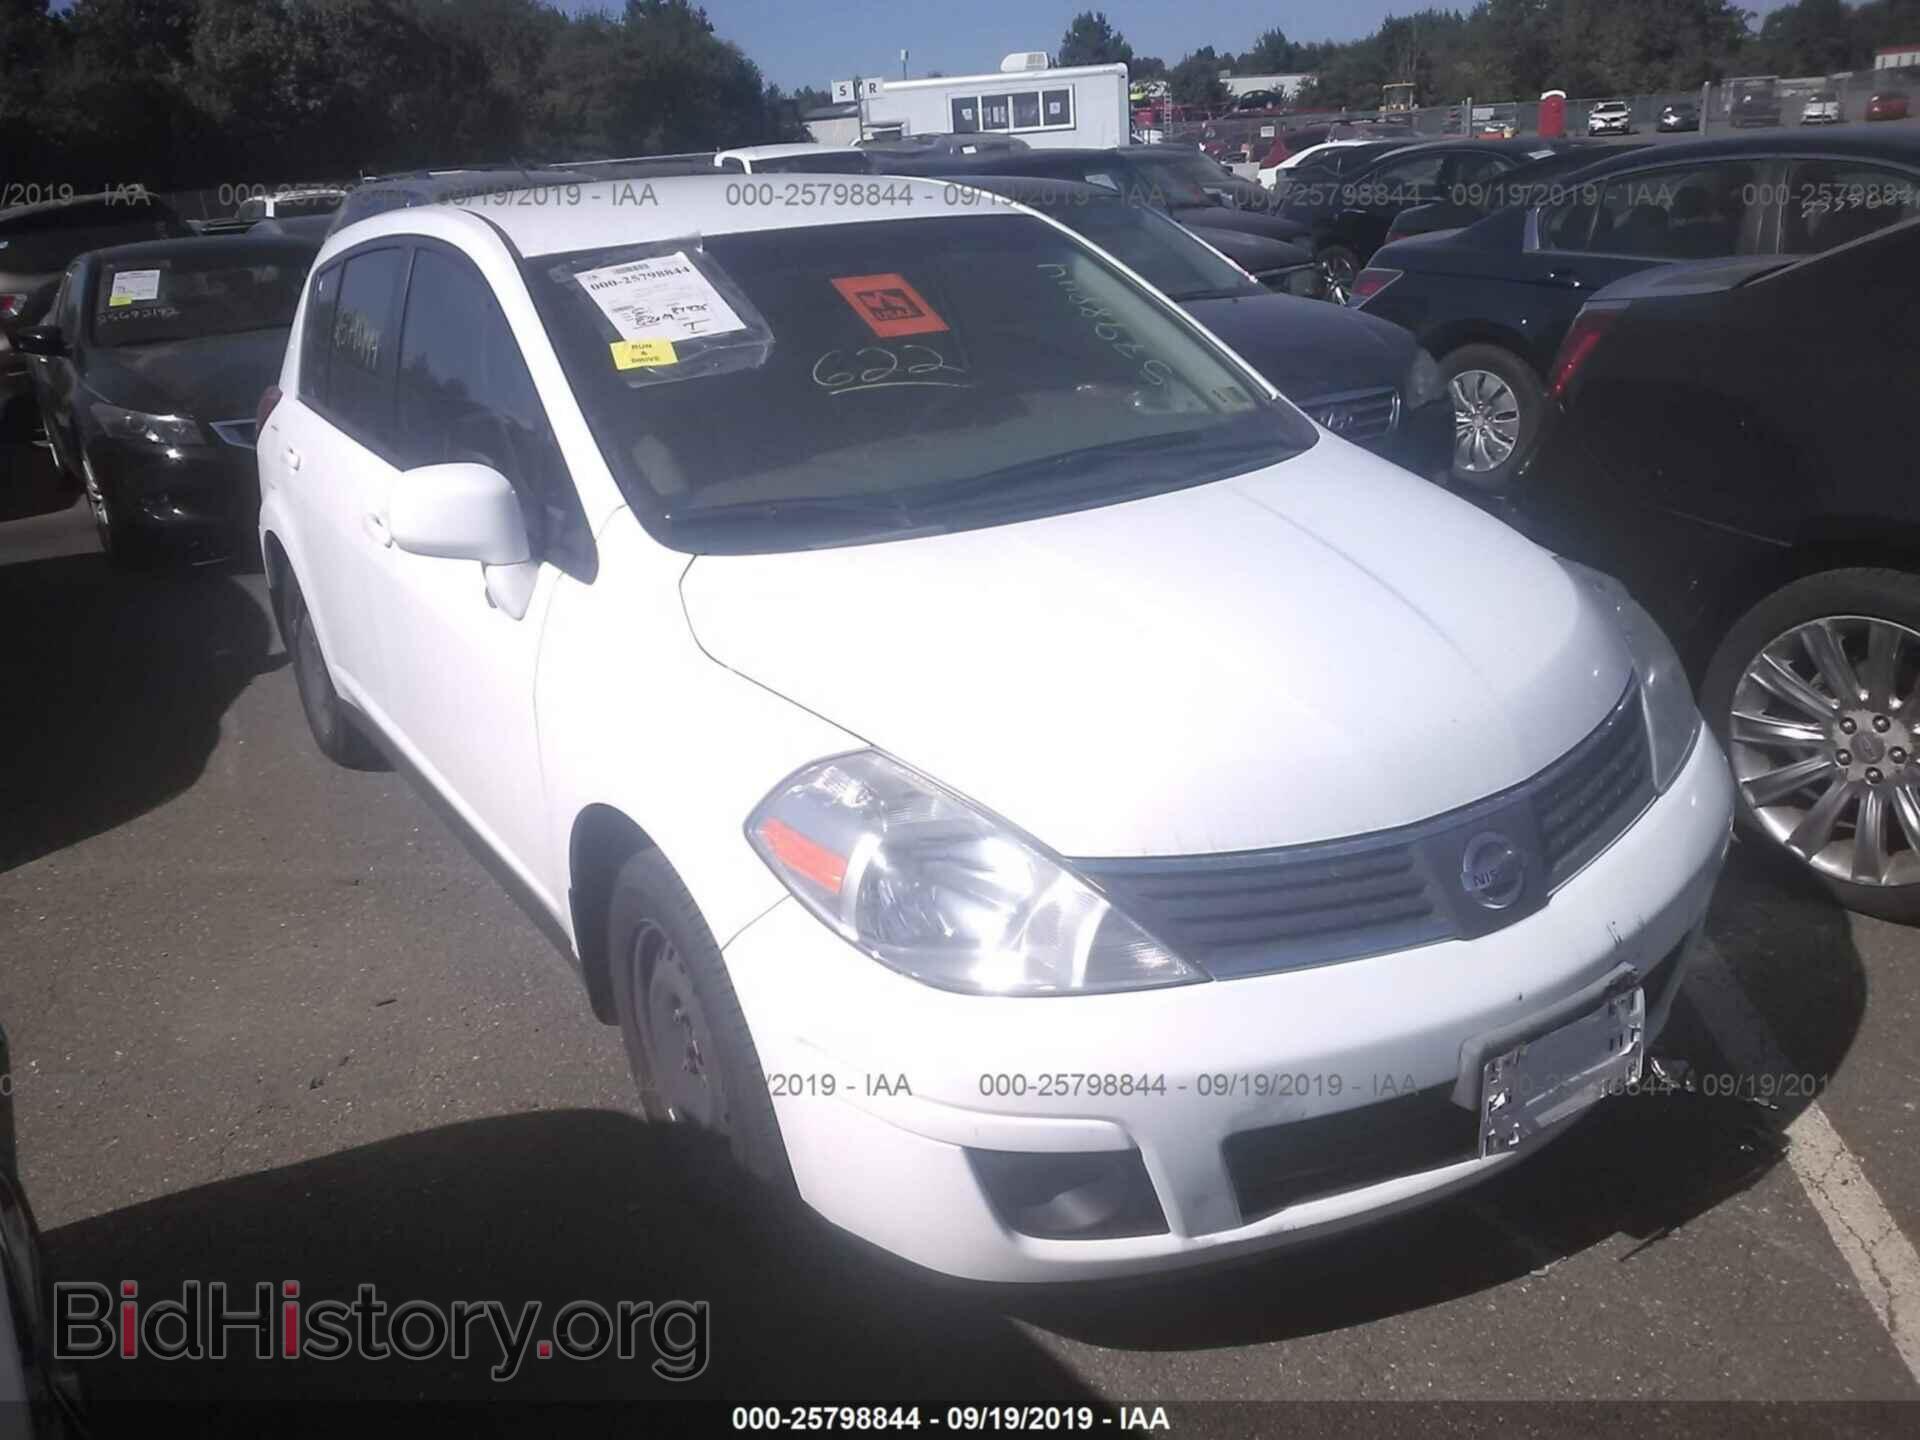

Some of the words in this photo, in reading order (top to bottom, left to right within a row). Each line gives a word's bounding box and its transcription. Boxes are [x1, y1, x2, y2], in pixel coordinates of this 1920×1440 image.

[839, 84, 847, 97] S
[868, 82, 877, 94] R
[813, 345, 966, 386] 622
